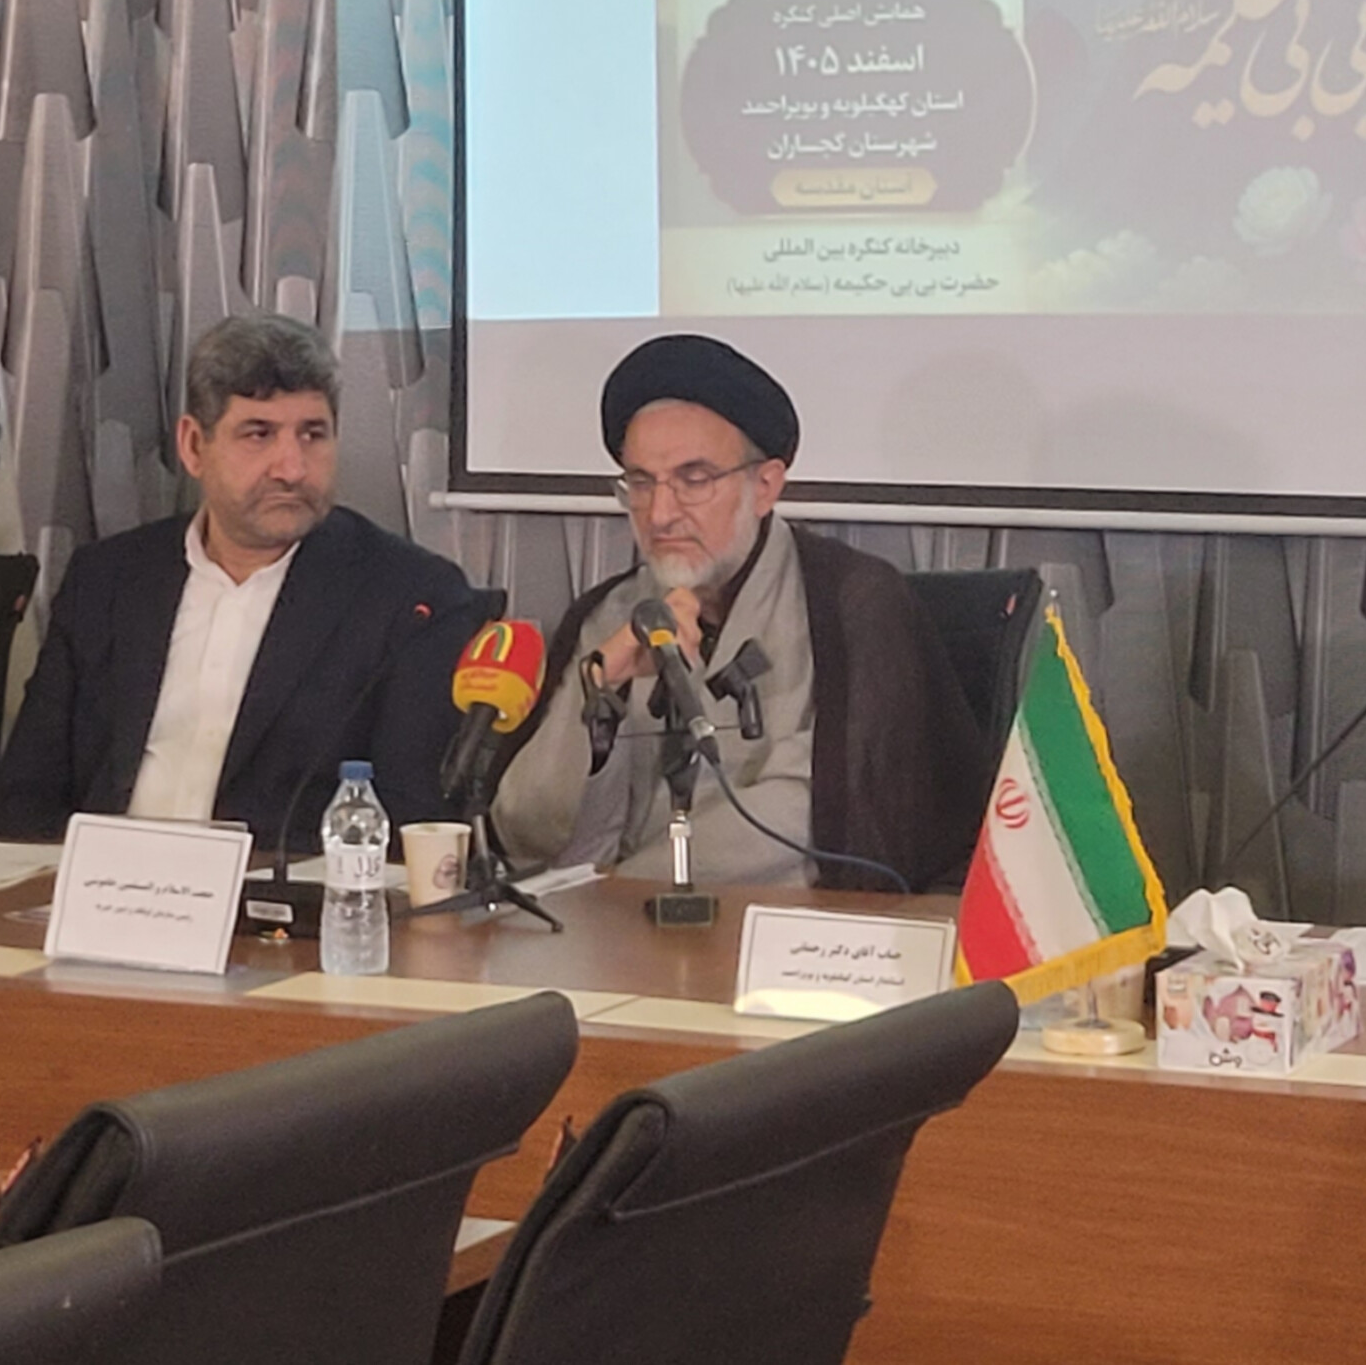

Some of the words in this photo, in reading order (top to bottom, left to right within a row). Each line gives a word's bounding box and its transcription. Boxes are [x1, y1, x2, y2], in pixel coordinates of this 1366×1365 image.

[772, 4, 816, 30] کنگره
[819, 3, 862, 29] اصلی
[864, 1, 926, 28] همایش
[776, 44, 839, 77] ۱۴۰۵
[846, 43, 924, 74] اسفند
[820, 100, 829, 119] و
[833, 92, 909, 119] کهگیلویه
[911, 90, 964, 117] استان
[848, 131, 937, 158] شهرستان
[763, 237, 815, 263] المللی
[816, 245, 845, 262] بین
[848, 237, 892, 262] کنگره
[895, 236, 960, 261] دبیرخانه
[833, 273, 888, 294] حکیمه
[890, 278, 911, 297] بی
[915, 278, 936, 297] بی
[939, 271, 1000, 296] حضرت
[828, 944, 850, 958] دکتر
[851, 944, 875, 960] آقای
